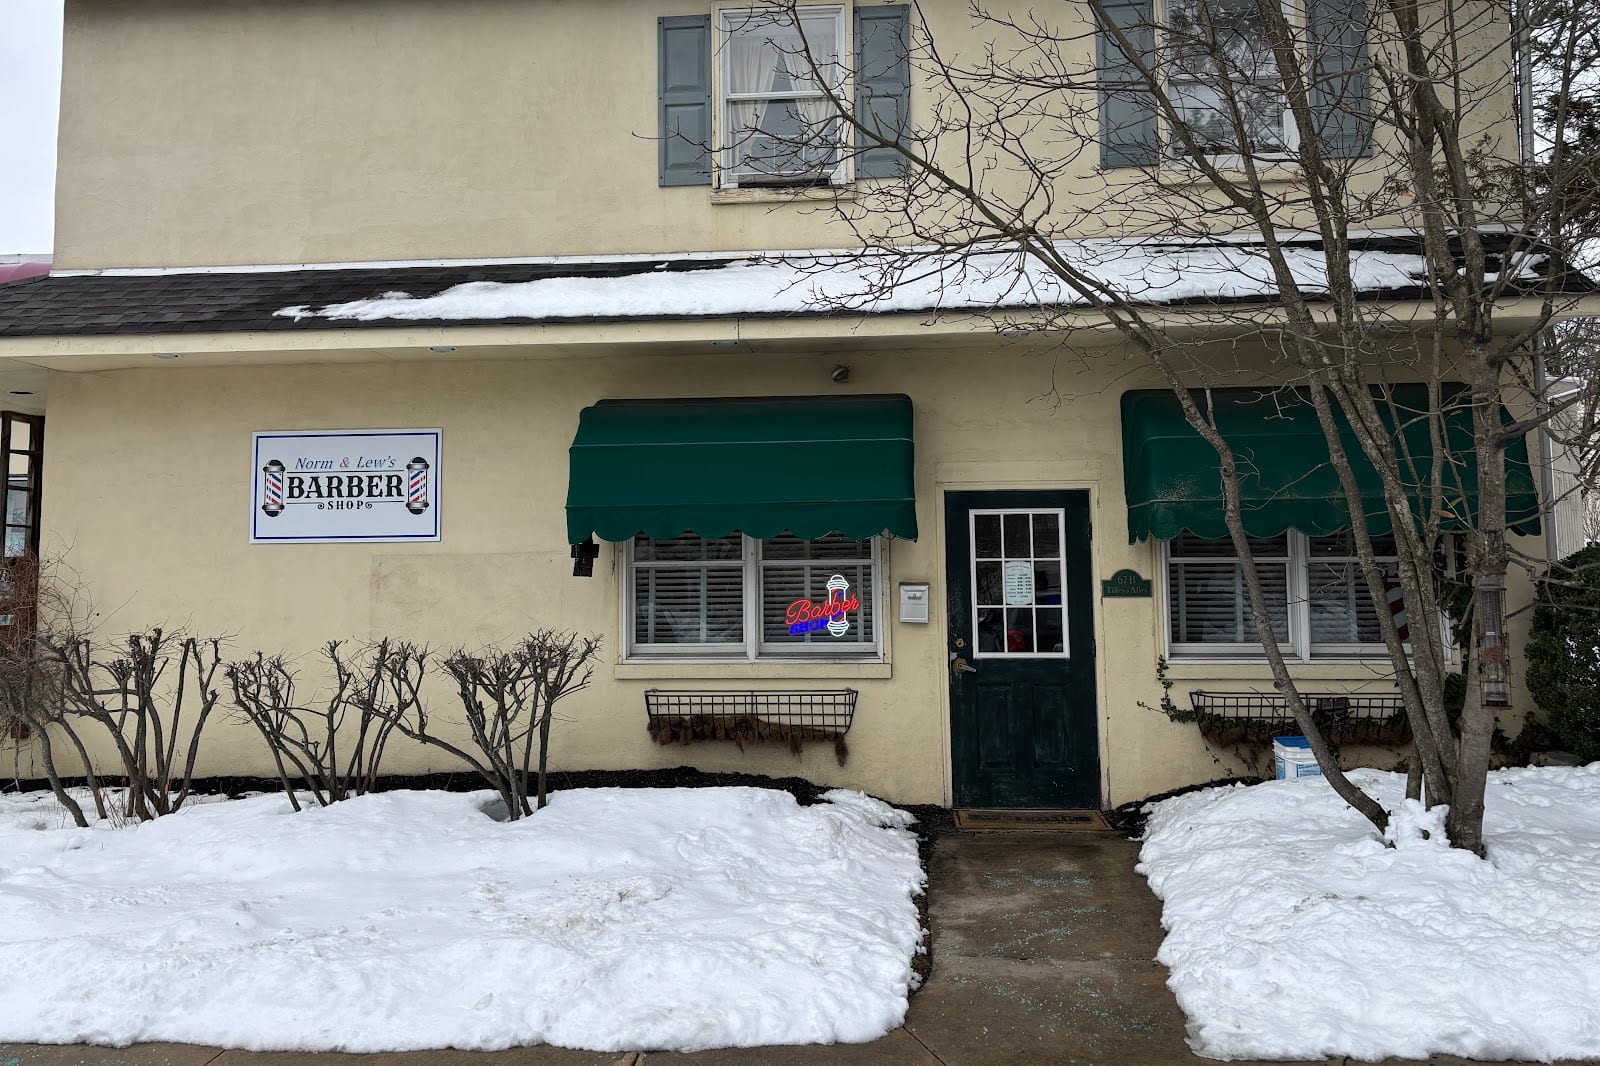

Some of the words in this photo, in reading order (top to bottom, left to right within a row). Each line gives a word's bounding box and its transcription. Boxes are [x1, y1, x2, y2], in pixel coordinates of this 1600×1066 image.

[295, 457, 333, 470] Norm
[339, 456, 350, 468] &
[356, 455, 397, 469] Lew's
[286, 474, 405, 499] BARBER
[327, 500, 364, 510] SHOP
[786, 592, 860, 625] Barber
